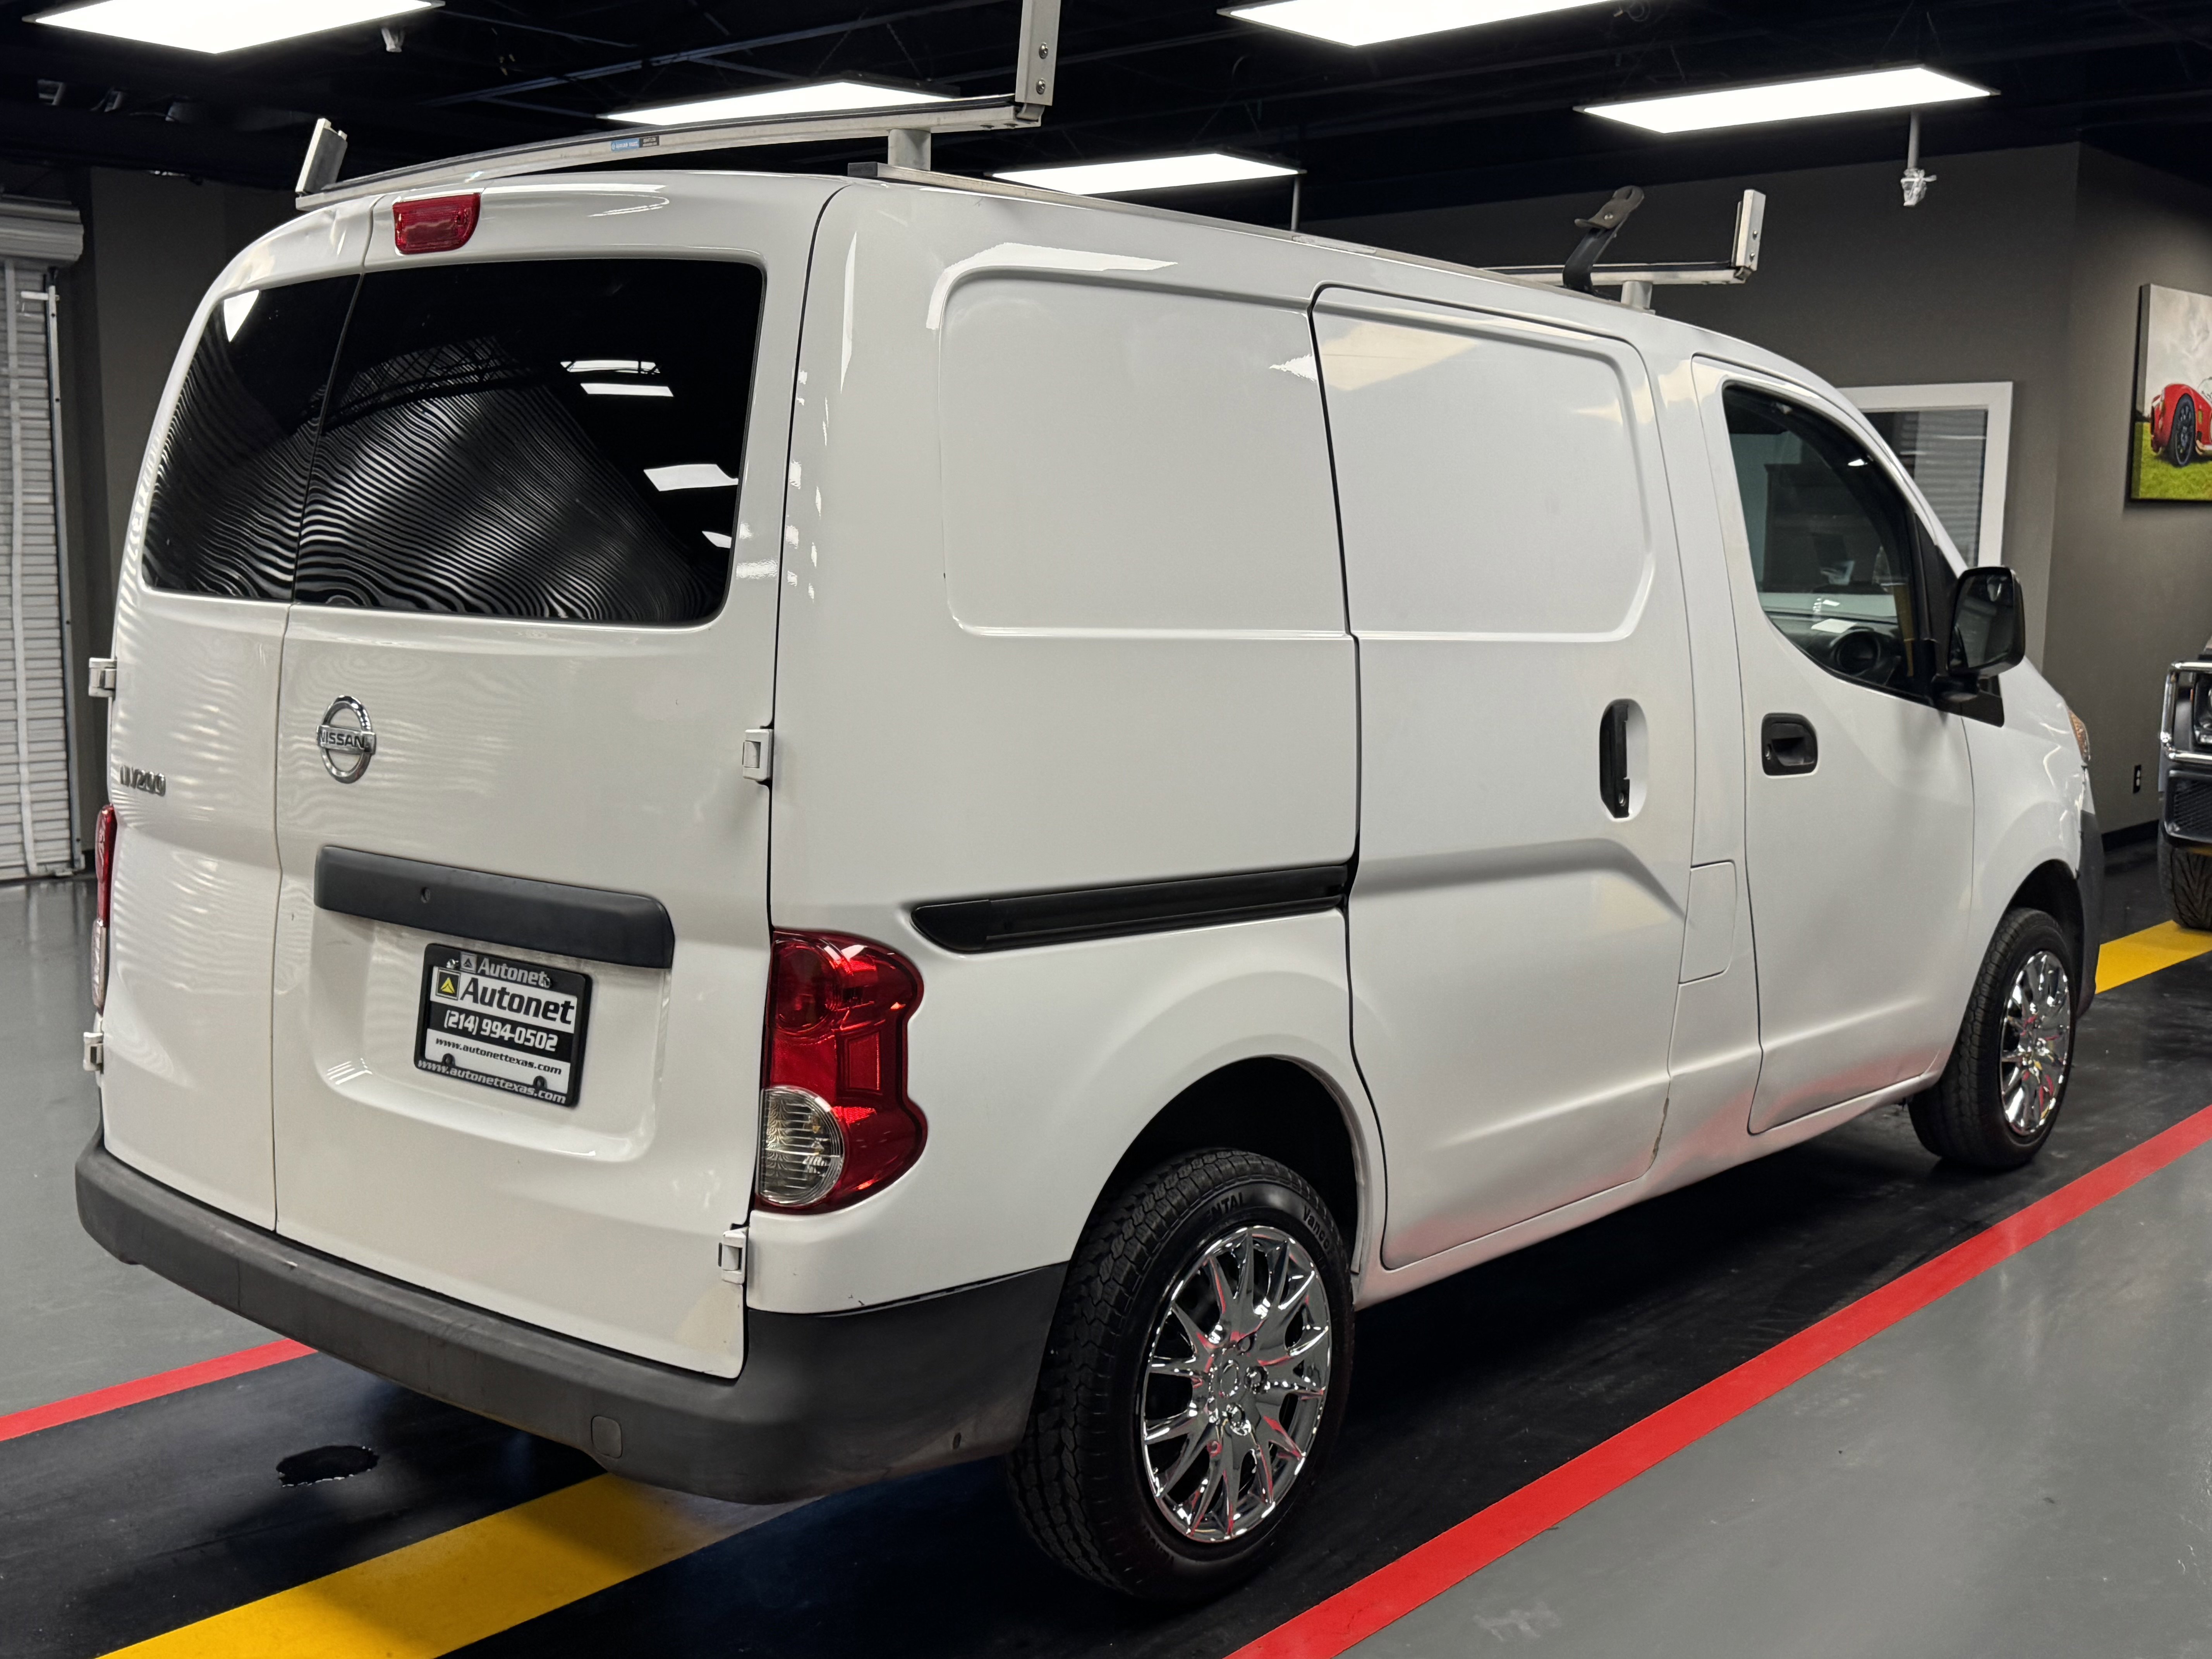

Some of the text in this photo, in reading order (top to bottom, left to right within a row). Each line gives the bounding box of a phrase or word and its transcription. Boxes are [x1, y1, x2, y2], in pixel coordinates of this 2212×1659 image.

[320, 730, 365, 748] NISSAN
[477, 957, 548, 987] Autonet
[460, 977, 574, 1025] Autonet
[444, 1010, 558, 1052] (214) 994-0502
[436, 1037, 562, 1075] www.autonettexas.com
[418, 1060, 566, 1104] www.autonettexas.com
